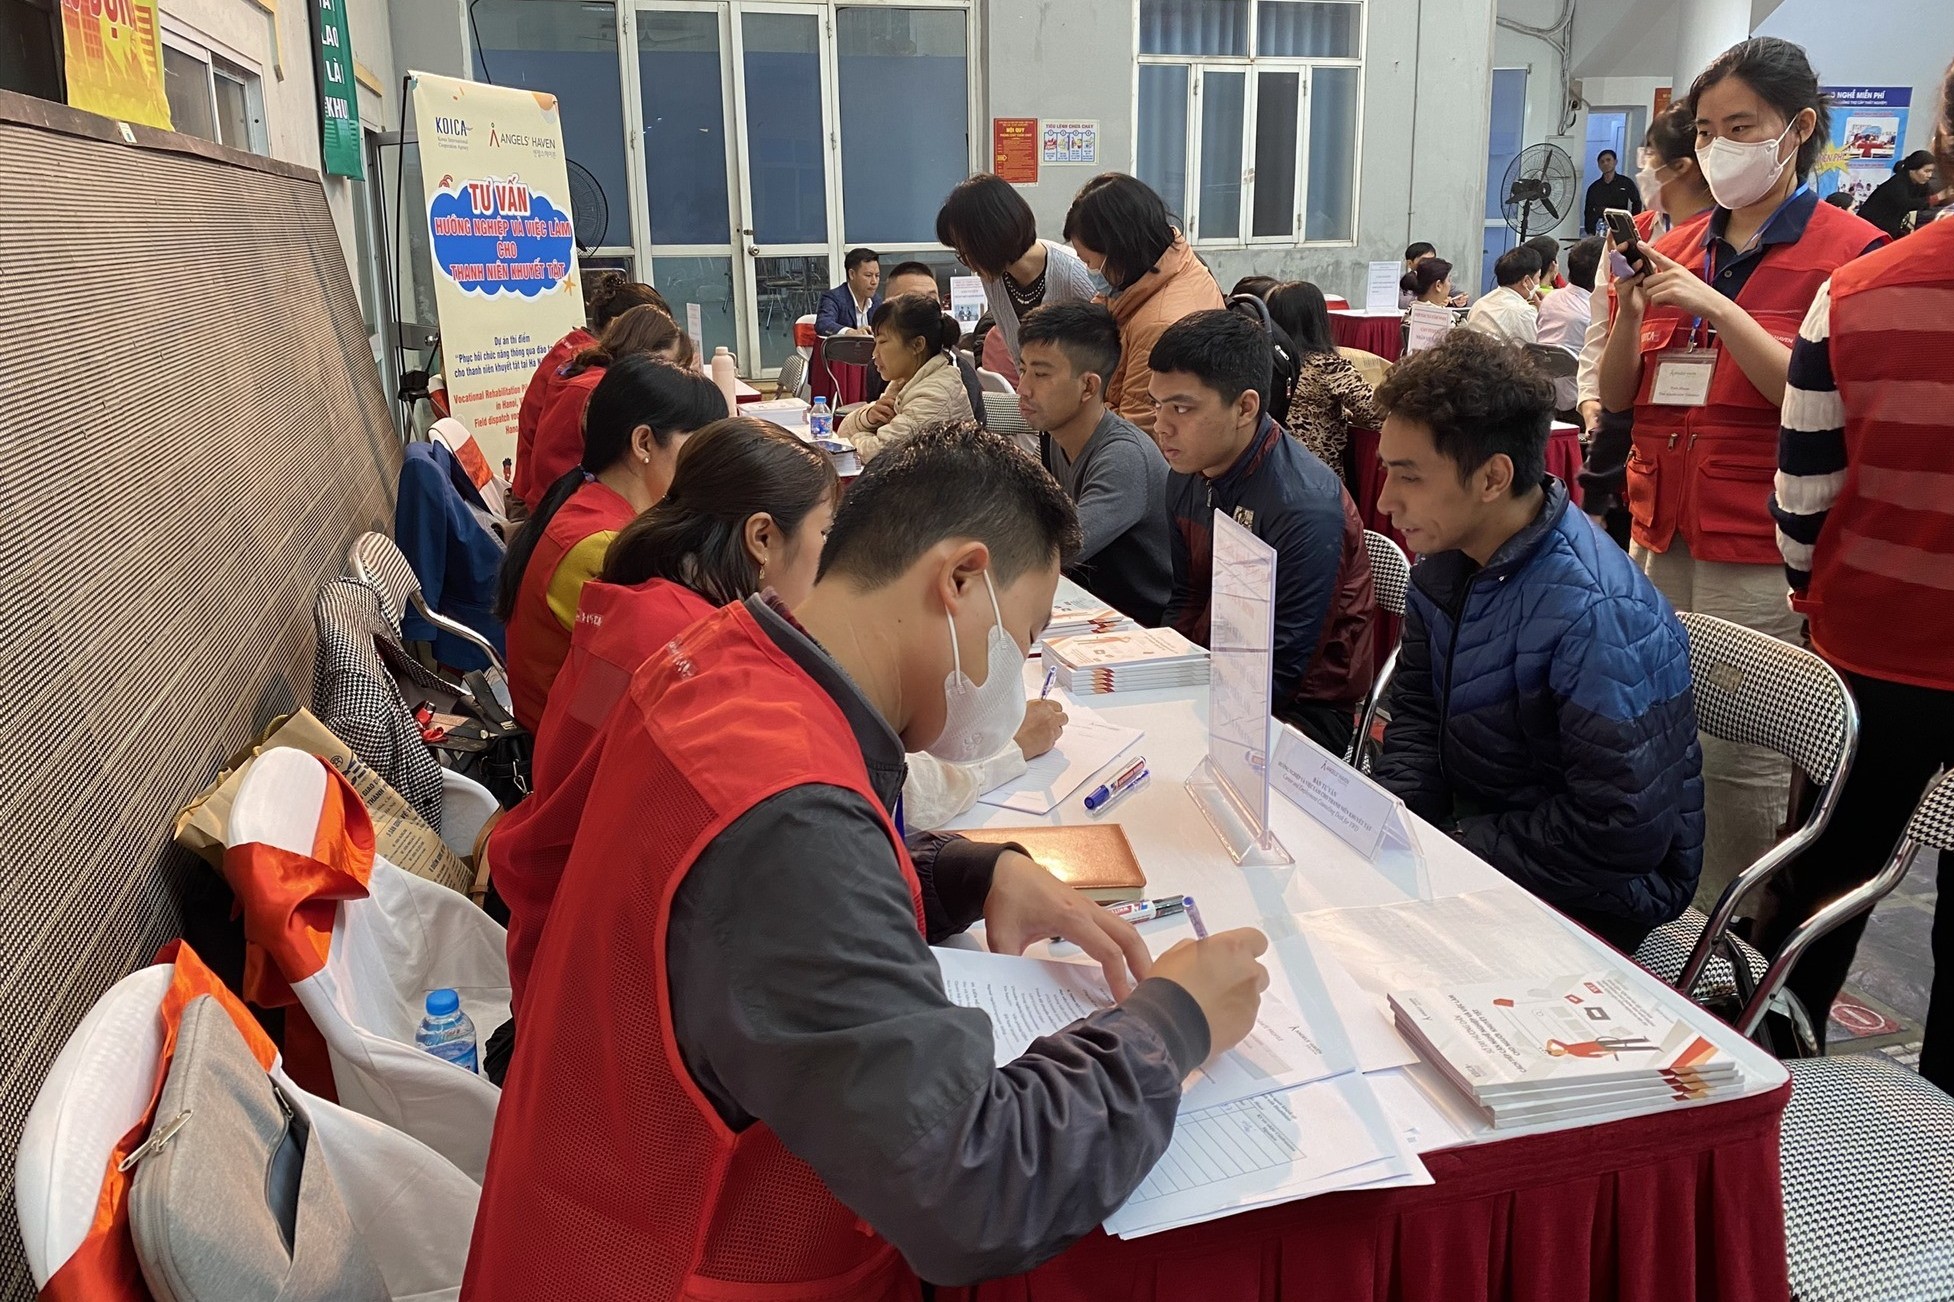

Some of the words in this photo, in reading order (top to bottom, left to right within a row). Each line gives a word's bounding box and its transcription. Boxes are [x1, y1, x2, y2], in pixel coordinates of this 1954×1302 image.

[1837, 89, 1855, 99] NGHỀ
[1873, 90, 1885, 99] PHÍ
[435, 116, 468, 136] KOICA
[531, 137, 556, 149] HAVEN
[468, 181, 493, 211] TƯ
[495, 176, 529, 213] VẤN
[474, 216, 509, 240] NGHIỆP
[511, 216, 524, 236] VÀ
[525, 217, 547, 240] VIỆC
[549, 218, 571, 237] LÀM
[497, 241, 518, 259] CHO
[450, 264, 484, 281] THANH
[486, 260, 508, 280] NIÊN
[510, 258, 545, 280] KHUYẾT
[547, 259, 565, 280] TẬT
[526, 348, 535, 357] qua
[455, 368, 465, 377] cho
[467, 365, 482, 376] thanh
[483, 363, 494, 373] niên
[495, 360, 512, 373] khuyết
[453, 391, 484, 404] Vocational
[485, 386, 521, 399] Rehabilitation
[502, 400, 518, 410] Hanoi,
[474, 416, 487, 428] Field
[488, 414, 510, 427] dispatch
[362, 783, 375, 796] GIAO
[367, 789, 384, 805] THÀNH
